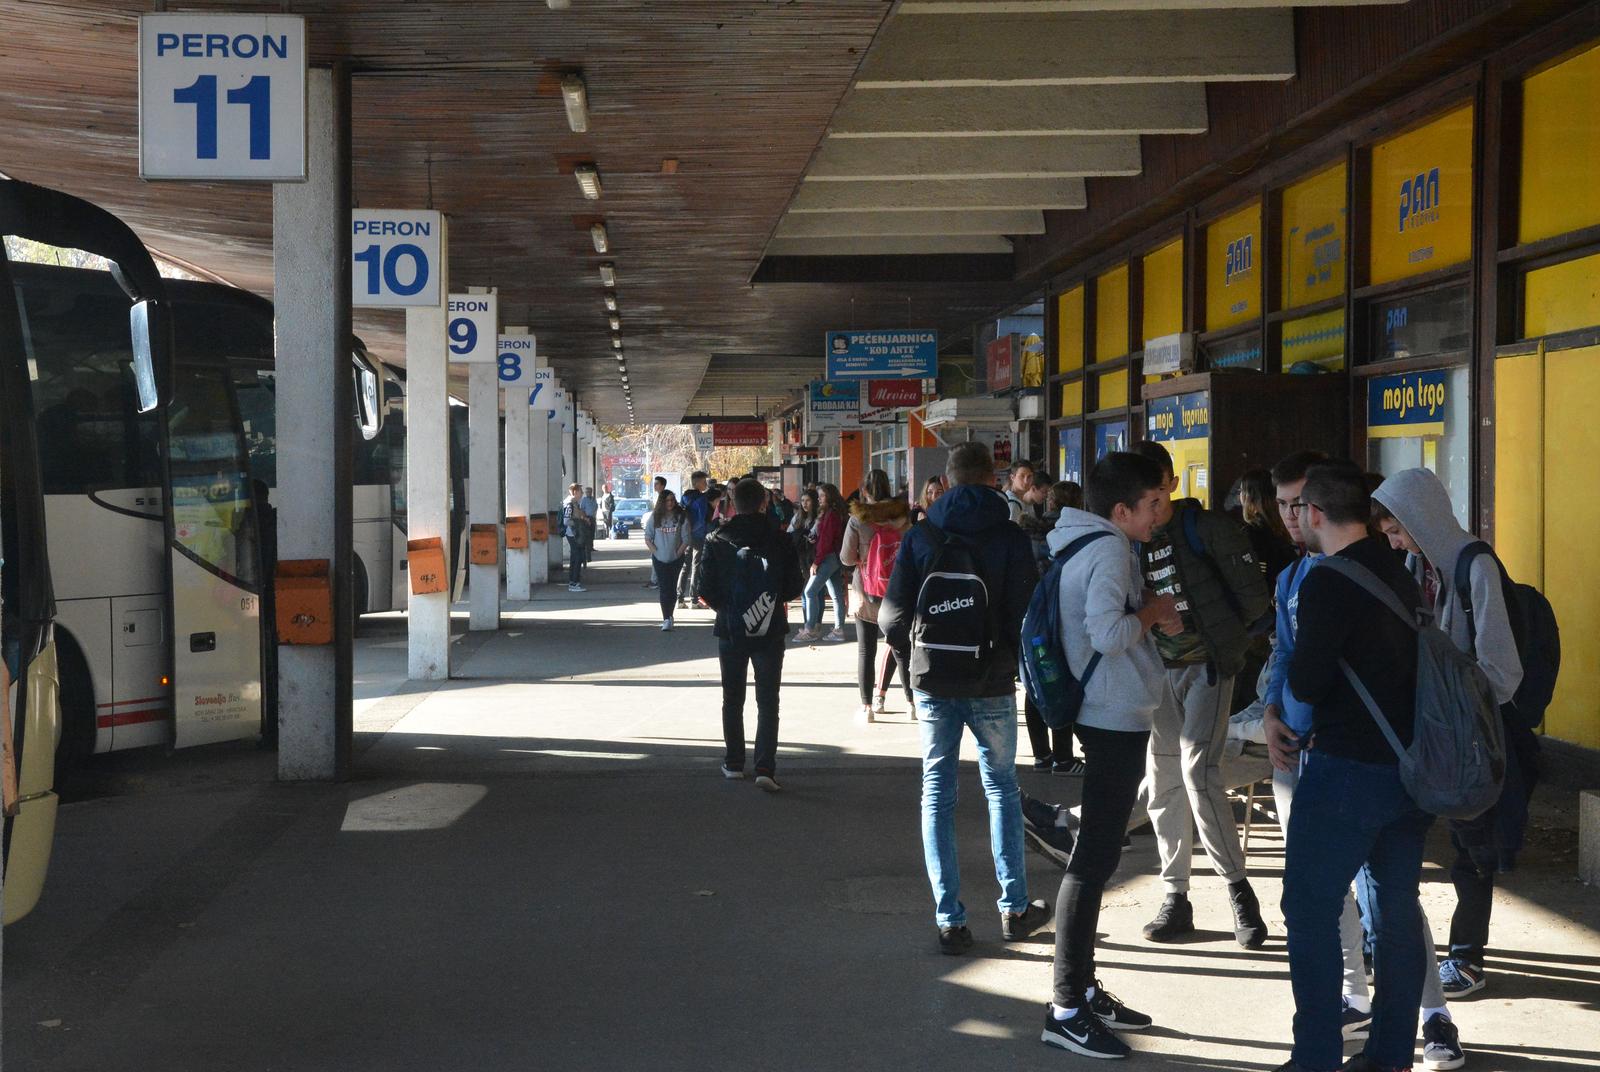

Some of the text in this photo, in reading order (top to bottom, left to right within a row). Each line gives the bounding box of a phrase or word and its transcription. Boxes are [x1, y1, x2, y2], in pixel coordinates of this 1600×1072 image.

[157, 33, 287, 58] PERON
[174, 75, 270, 160] 11
[353, 220, 430, 236] PERON
[354, 243, 429, 296] 10
[448, 302, 488, 312] ERON
[448, 318, 477, 354] 9
[498, 340, 531, 349] ERON
[498, 353, 522, 381] 8
[1384, 377, 1445, 418] moja trgo
[1156, 402, 1208, 435] moja trgovina
[698, 437, 712, 445] WC
[742, 591, 772, 631] NIKE
[928, 595, 975, 614] adidas
